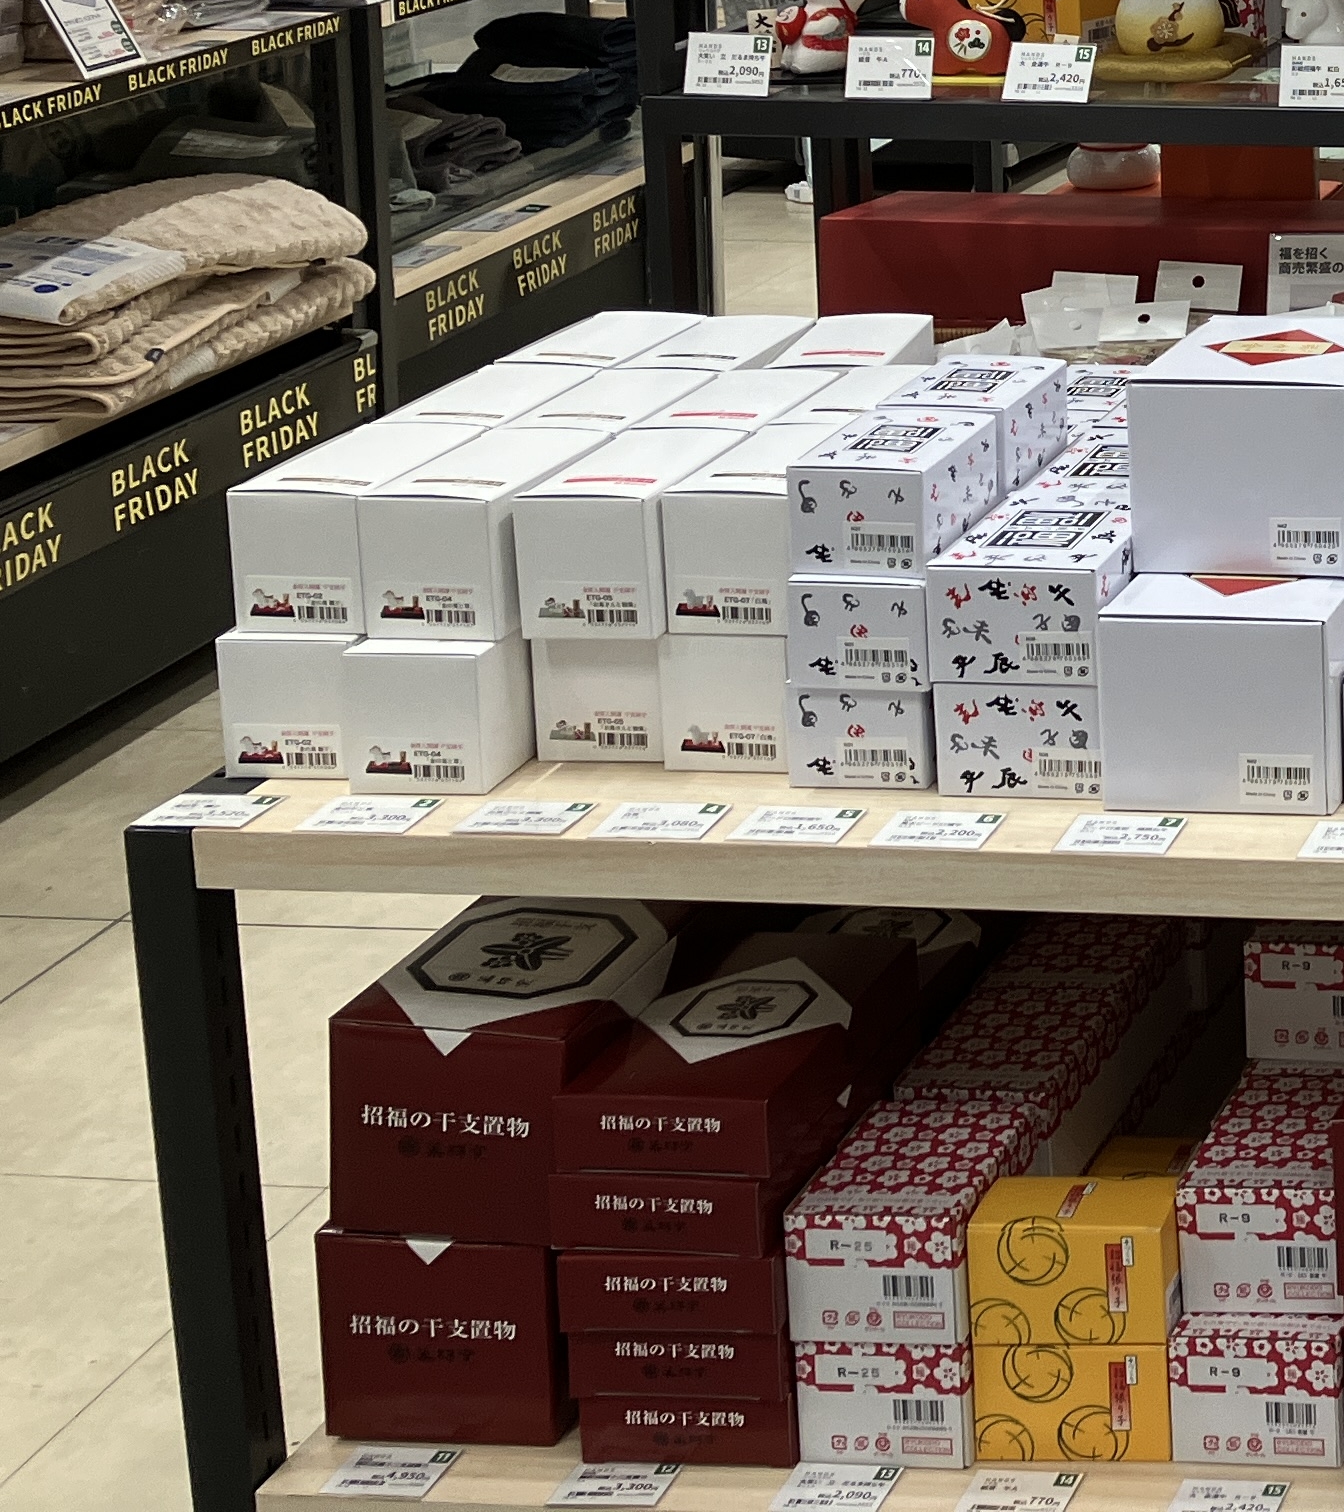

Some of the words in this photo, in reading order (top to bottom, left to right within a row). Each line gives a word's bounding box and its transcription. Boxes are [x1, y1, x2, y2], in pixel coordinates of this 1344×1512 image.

[128, 61, 175, 91] BLACK
[178, 48, 228, 79] FRIDAY
[252, 30, 294, 56] BLACK
[297, 16, 341, 44] FRIDAY
[755, 39, 768, 51] 13
[1279, 247, 1328, 259] 福を招く
[425, 269, 480, 313] BLACK
[428, 293, 486, 342] FRIDAY
[239, 384, 311, 436] BLACK
[241, 410, 319, 469] FRIDAY
[110, 439, 189, 497] BLACK
[112, 468, 199, 533] FRIDAY
[361, 1104, 530, 1139] 招福の干支置物
[600, 1114, 721, 1134] 招福の干支置物
[1219, 1212, 1251, 1224] R-9
